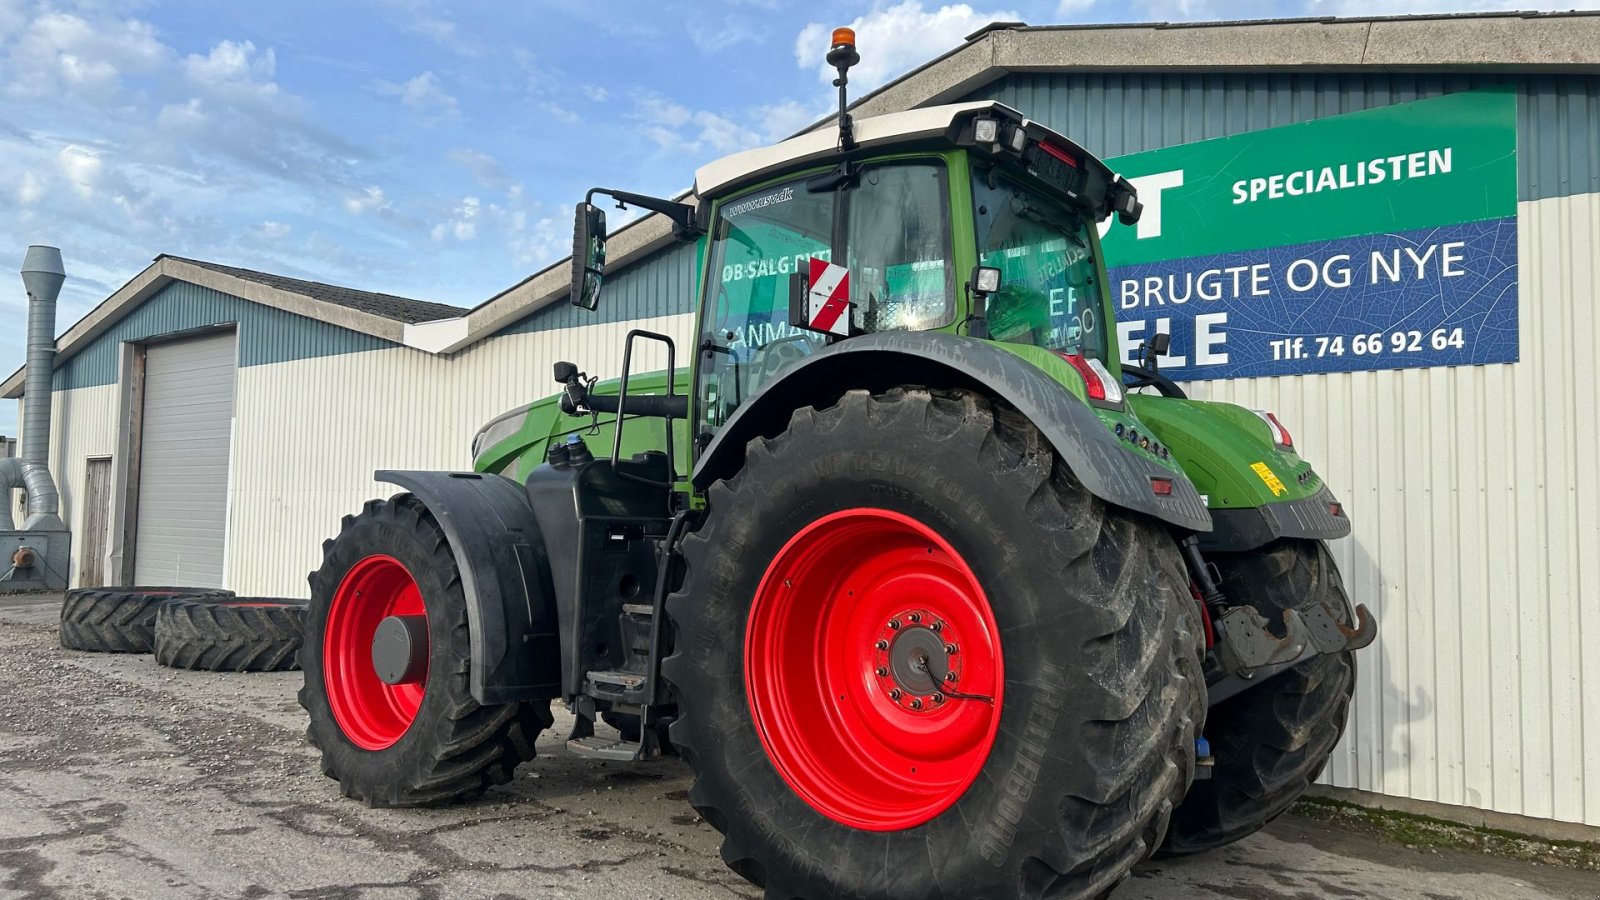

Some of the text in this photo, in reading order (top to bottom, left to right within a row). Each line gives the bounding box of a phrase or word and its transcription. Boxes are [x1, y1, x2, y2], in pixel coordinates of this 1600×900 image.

[1232, 147, 1452, 204] SPECIALISTEN
[1121, 241, 1465, 309] BRUGTE OG NYE
[1270, 327, 1465, 361] Tlf. 74 66 92 64
